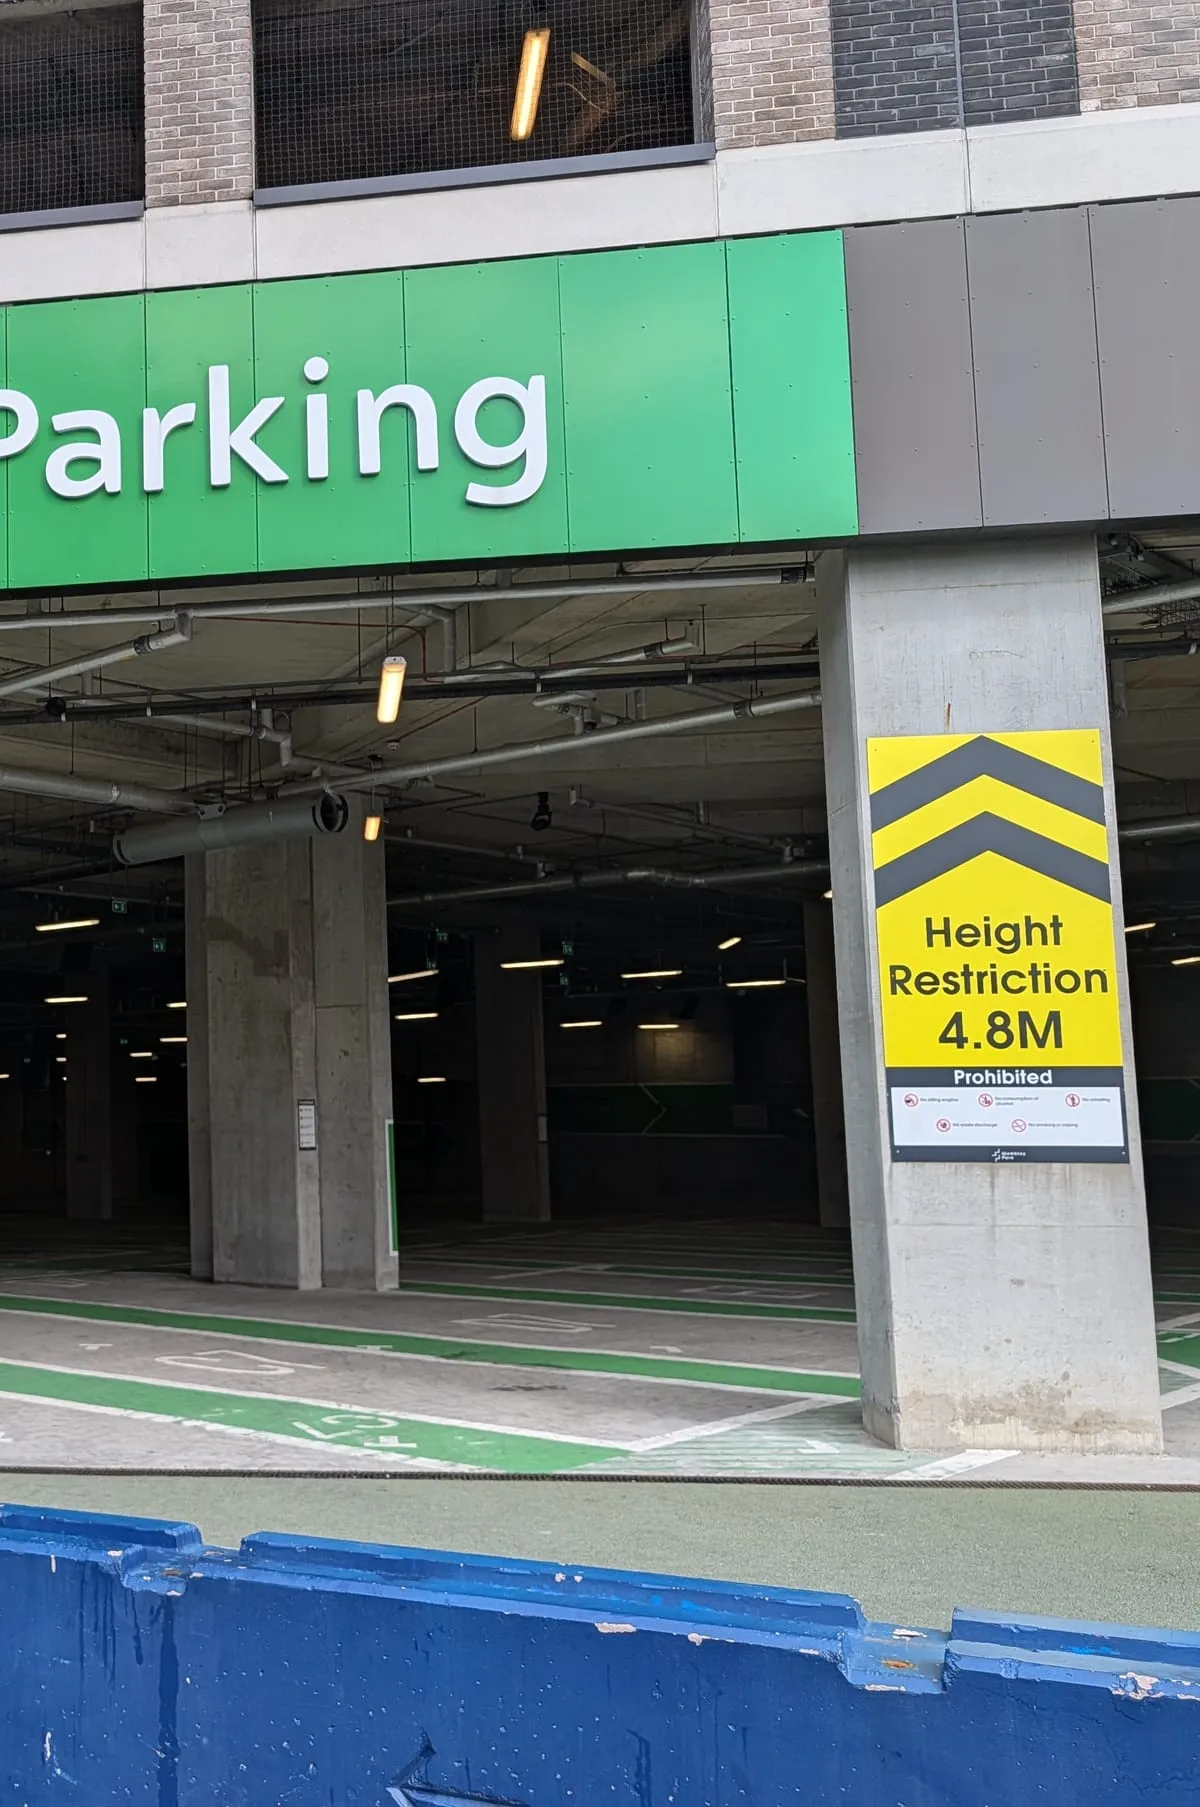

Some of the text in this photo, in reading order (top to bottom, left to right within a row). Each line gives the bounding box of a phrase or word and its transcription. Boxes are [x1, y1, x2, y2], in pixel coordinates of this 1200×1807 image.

[925, 915, 1063, 954] Height
[889, 963, 1108, 996] Restriction
[938, 1010, 1063, 1049] 4.8M
[953, 1069, 1052, 1085] Prohibited
